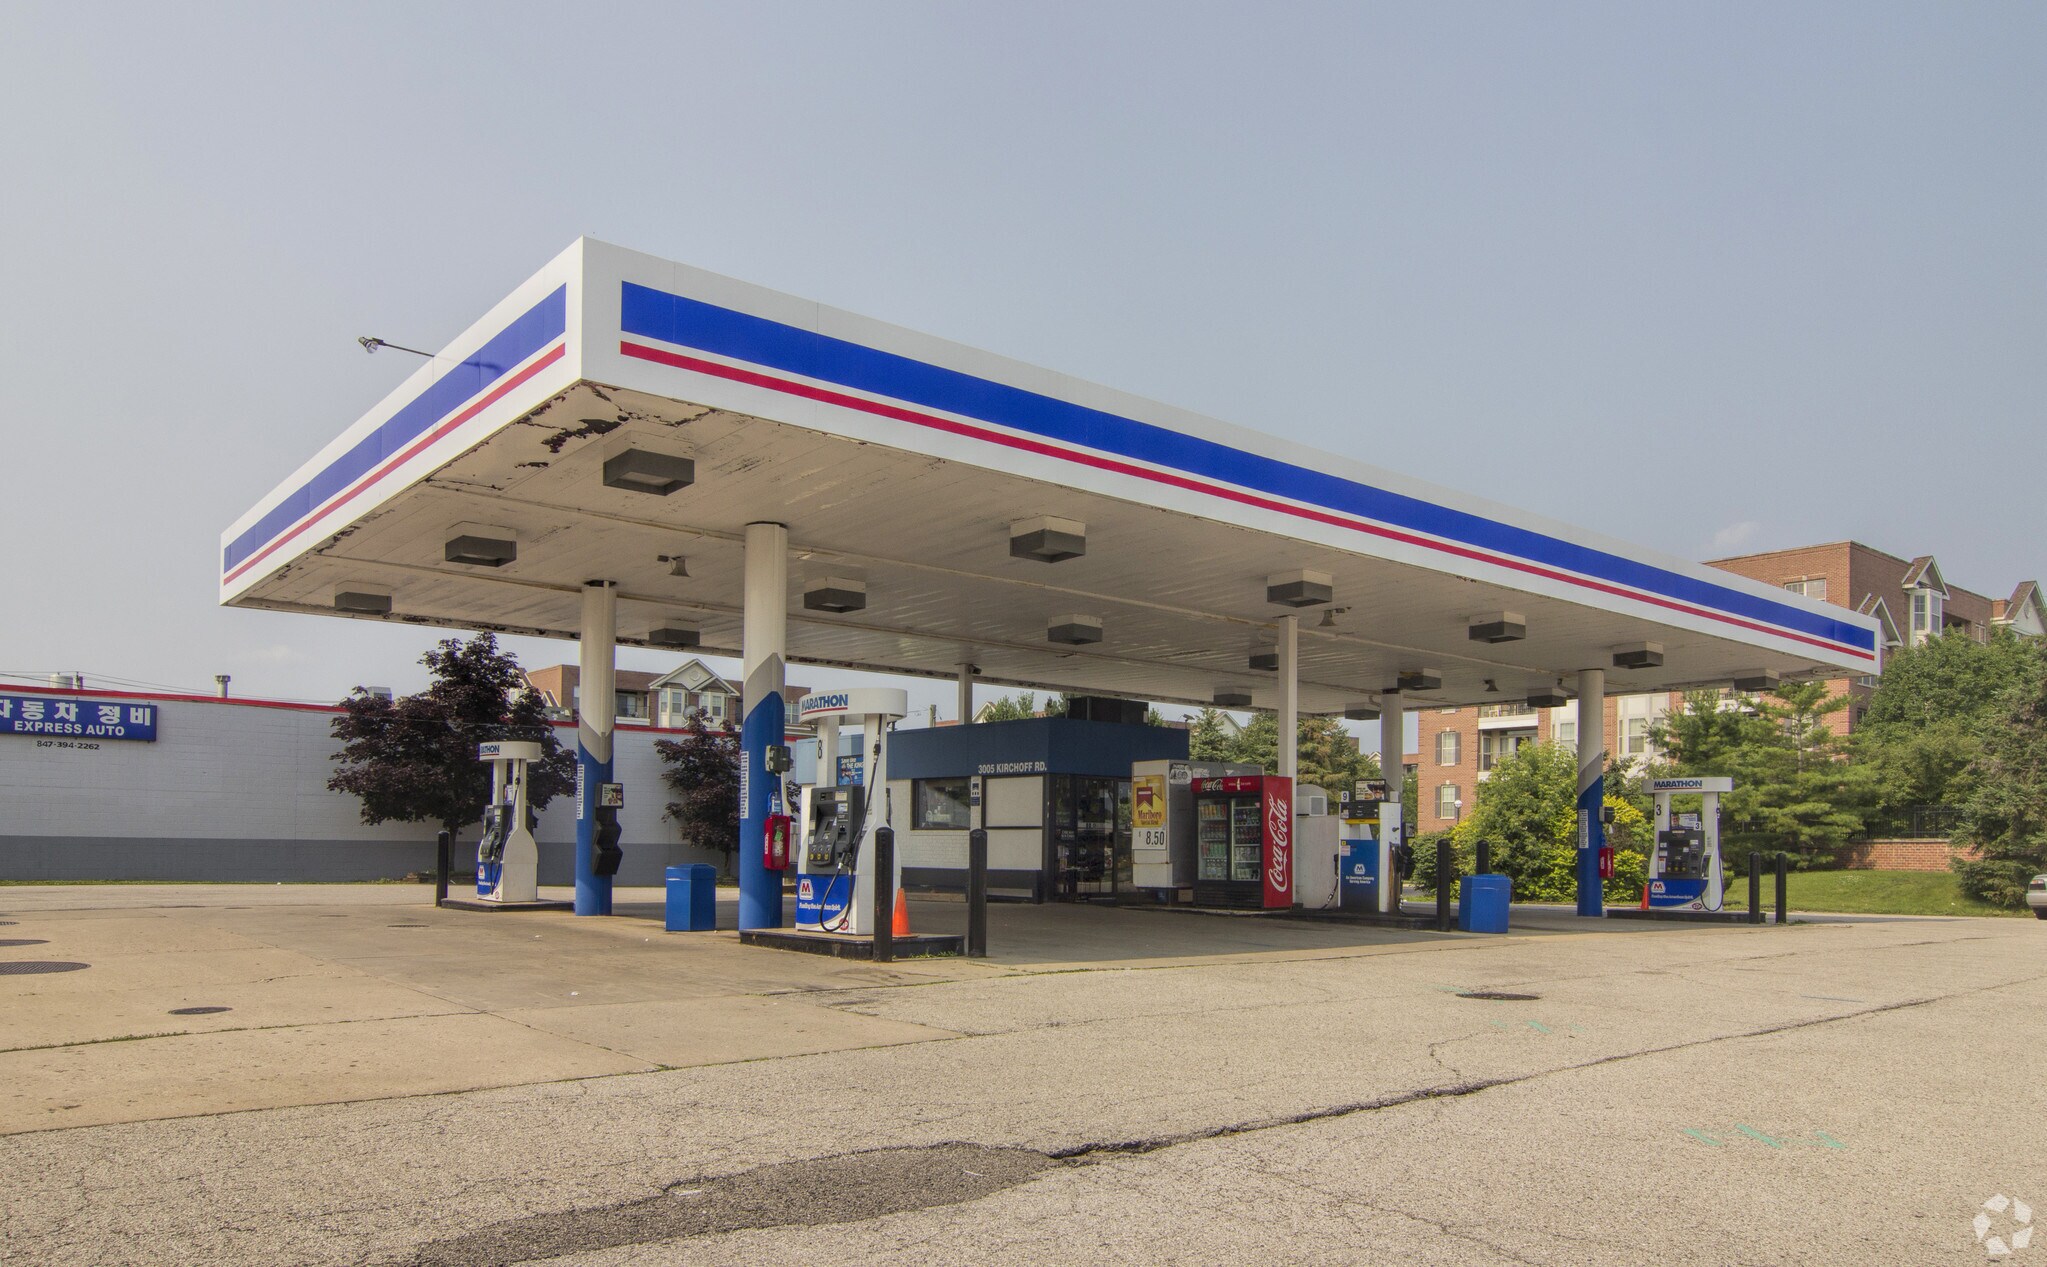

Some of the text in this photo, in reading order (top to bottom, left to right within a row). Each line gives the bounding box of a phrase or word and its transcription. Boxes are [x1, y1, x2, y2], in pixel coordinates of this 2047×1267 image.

[801, 694, 849, 711] MARATHON
[98, 704, 151, 726] 정비
[14, 720, 125, 736] EXPRESS AUTO
[36, 740, 100, 750] 847-394-2262
[817, 739, 823, 760] 8
[978, 761, 1047, 774] 3005 KIRCHOFF RD.
[1653, 780, 1702, 789] MARATHON
[1138, 809, 1162, 820] Marlboro
[1656, 804, 1662, 816] 3
[1695, 822, 1700, 830] 3
[1145, 830, 1165, 846] 8.50
[1268, 792, 1288, 892] Coca-Cola
[802, 883, 811, 892] M
